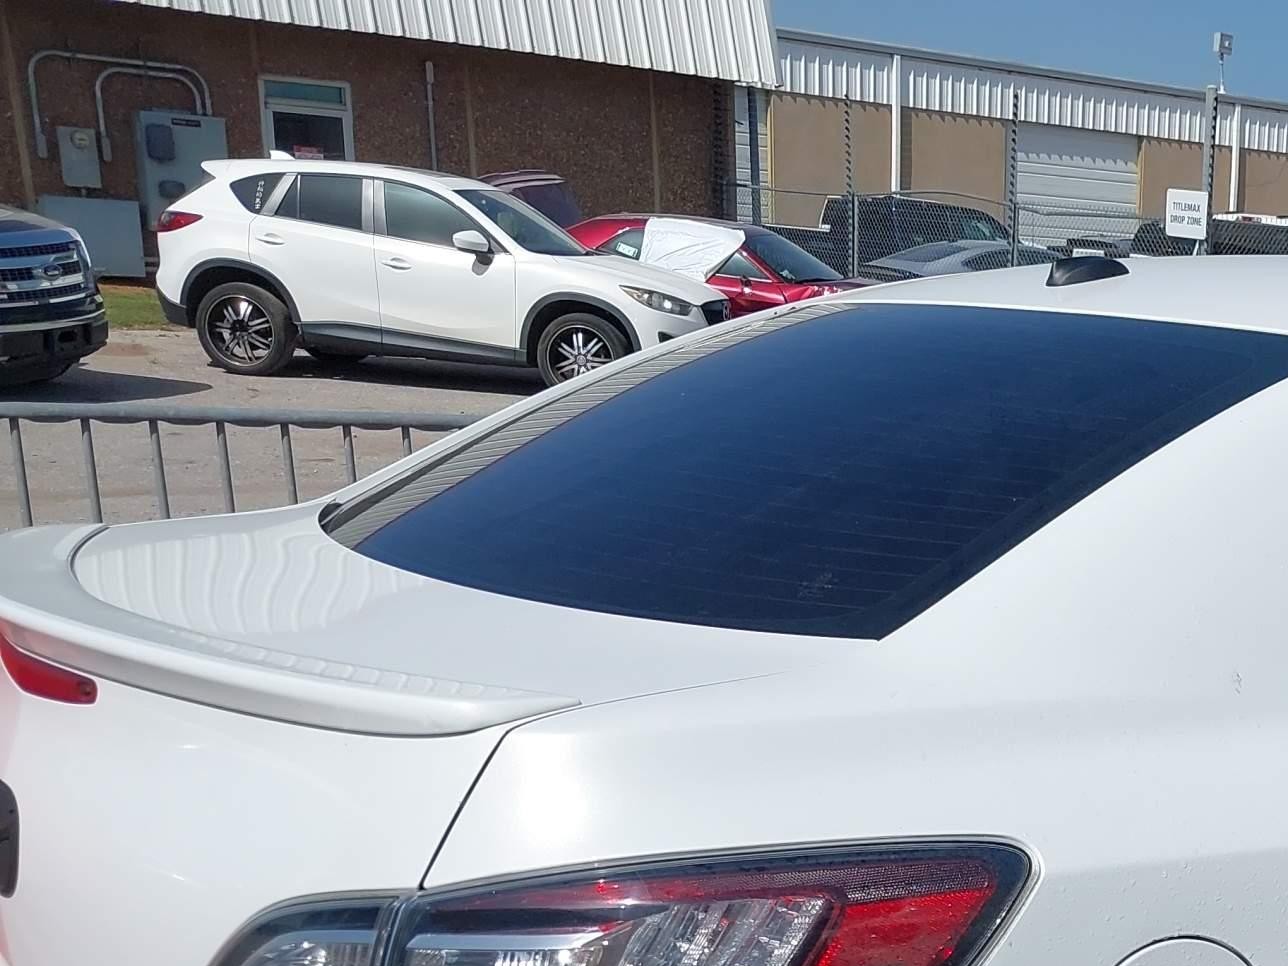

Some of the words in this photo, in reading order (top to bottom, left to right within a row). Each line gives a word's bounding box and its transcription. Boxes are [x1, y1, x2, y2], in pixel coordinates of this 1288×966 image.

[1172, 201, 1201, 212] TITLEMAX
[1170, 214, 1185, 225] DROP
[1186, 216, 1202, 226] ZONE
